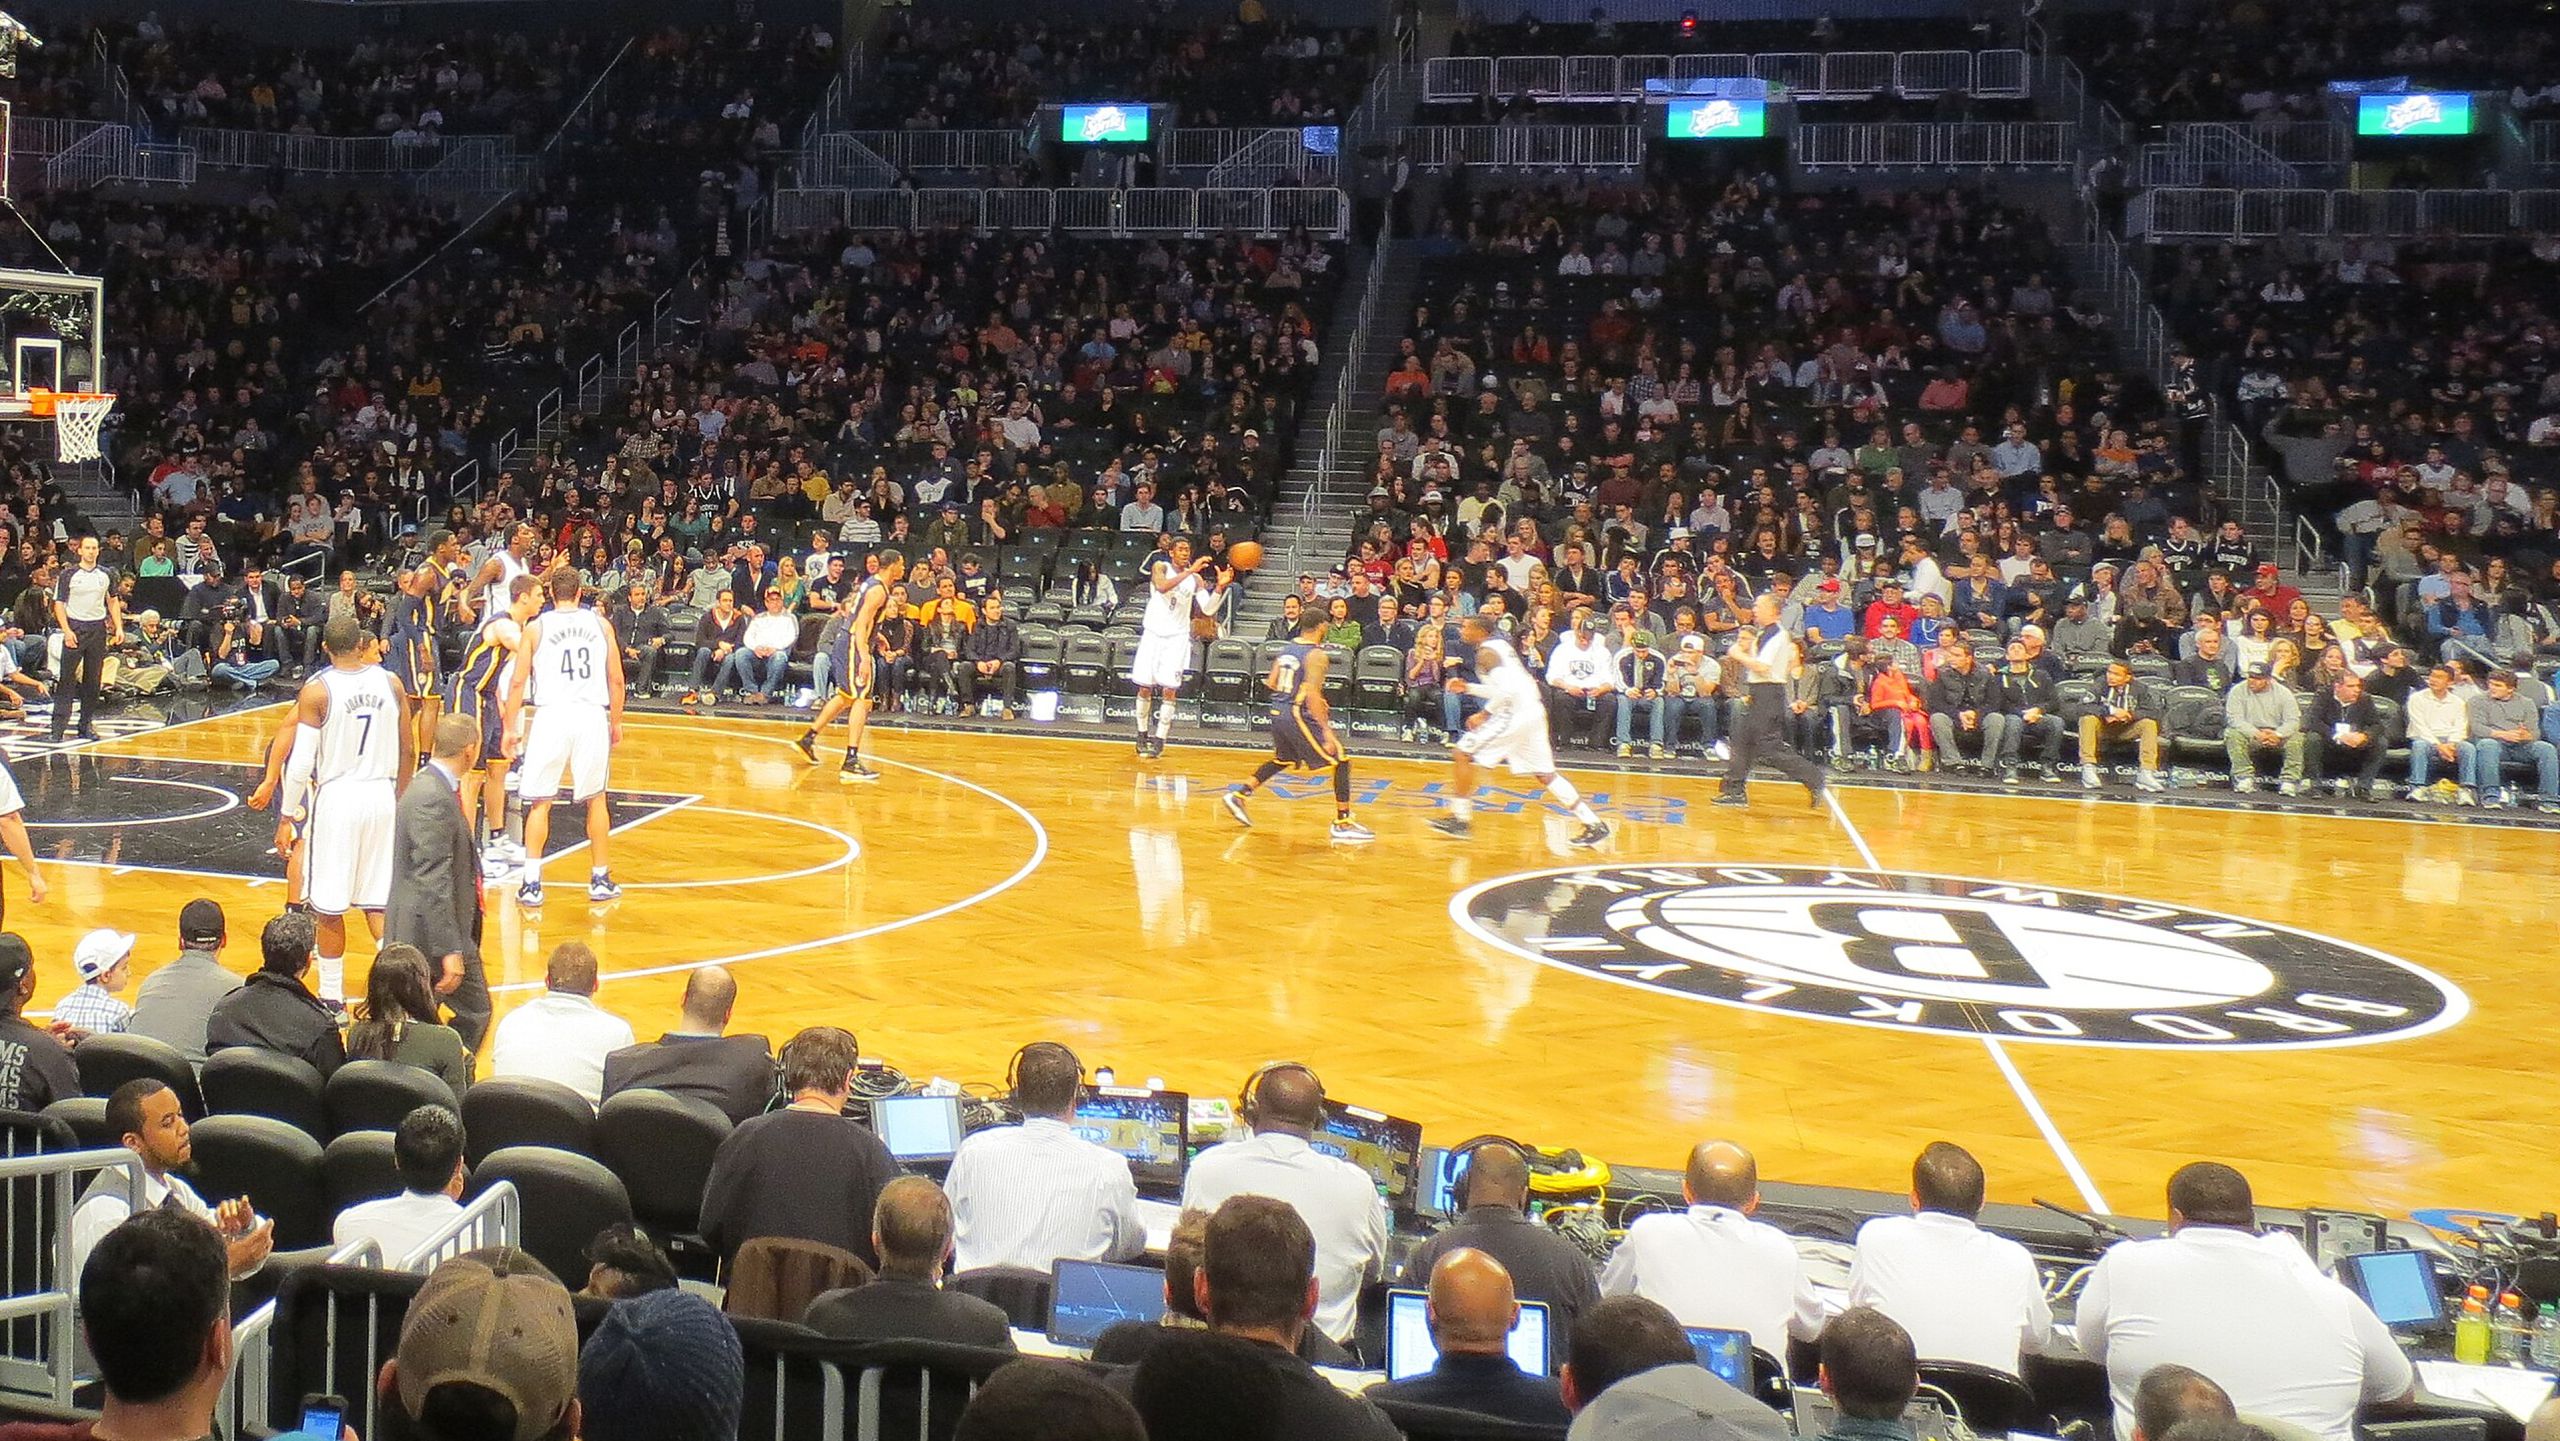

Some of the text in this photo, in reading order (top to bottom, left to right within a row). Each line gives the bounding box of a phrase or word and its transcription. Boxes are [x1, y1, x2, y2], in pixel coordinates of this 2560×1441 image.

[560, 647, 591, 681] 43
[344, 694, 385, 714] JOHNSON
[1057, 705, 1099, 716] Calvin Klein
[1106, 708, 1130, 718] Calvin
[1202, 713, 1246, 725] Calvin Klein
[1351, 722, 1377, 732] Calvin
[1377, 724, 1397, 733] Klein
[357, 714, 371, 756] 7
[1552, 867, 2276, 938] NEW YORK
[1523, 936, 2409, 1040] BROOKLYN
